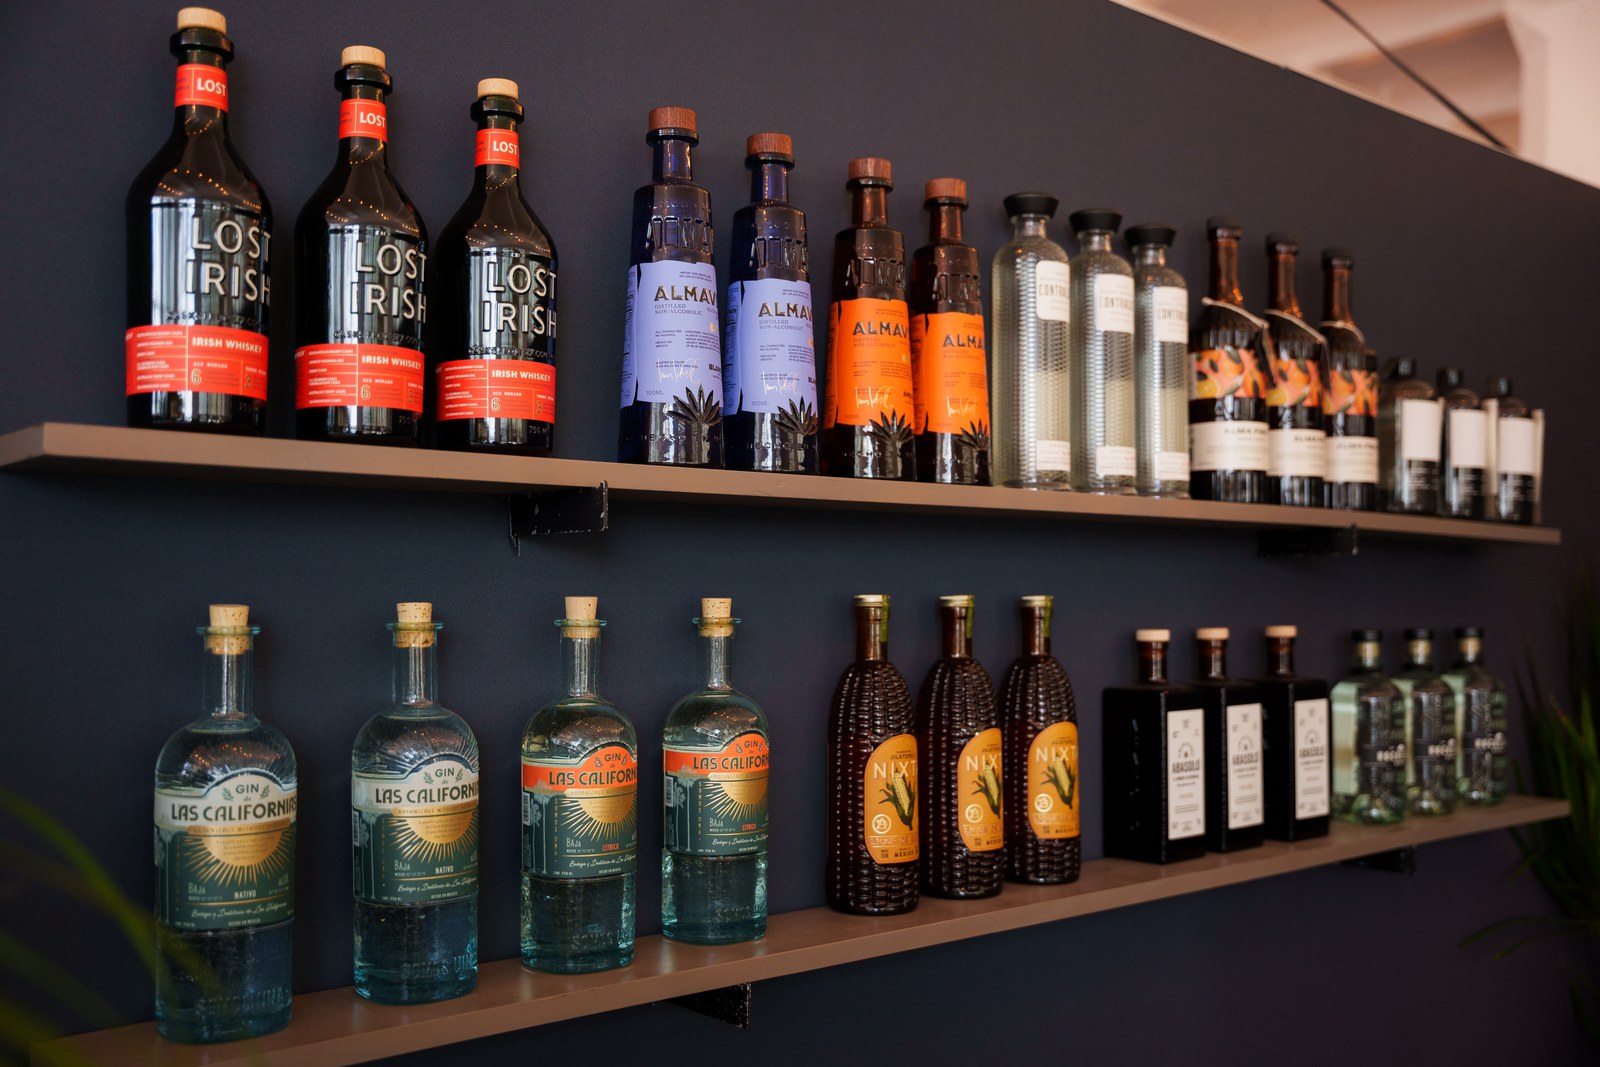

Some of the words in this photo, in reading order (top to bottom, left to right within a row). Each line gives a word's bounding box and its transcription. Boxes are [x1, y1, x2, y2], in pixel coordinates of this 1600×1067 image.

[197, 77, 227, 96] LOST
[360, 111, 385, 128] LOST
[493, 140, 517, 155] LOST
[193, 215, 272, 263] LOST
[356, 240, 427, 283] LOST
[187, 260, 271, 306] IRISH
[486, 261, 556, 300] LOST
[351, 281, 427, 323] IRISH
[483, 300, 557, 338] IRISH
[654, 308, 703, 316] NON-ALCOHOLIC
[192, 337, 223, 349] IRISH
[225, 340, 263, 354] WHISKEY
[943, 334, 983, 349] ALMA
[362, 355, 389, 365] IRISH
[391, 357, 421, 370] WHISKEY
[191, 368, 202, 385] 6
[245, 373, 252, 390] 3
[492, 369, 518, 379] IRISH
[520, 372, 551, 382] WHISKEY
[361, 384, 371, 400] 6
[491, 397, 501, 412] 6
[536, 400, 543, 415] 3
[744, 740, 758, 749] GIN
[604, 753, 621, 762] GIN
[1036, 745, 1077, 763] NIXT
[1232, 752, 1259, 766] ABASOLO
[693, 756, 718, 769] LAS
[874, 760, 917, 779] NIXT
[1171, 759, 1200, 774] ABASOLO
[435, 767, 455, 778] GIN
[549, 771, 575, 786] LAS
[235, 783, 259, 794] GIN
[376, 788, 402, 804] LAS
[406, 780, 479, 804] CALIFORNI
[172, 803, 199, 821] LAS
[709, 817, 724, 827] BAJA
[566, 837, 582, 848] BAJA
[394, 859, 411, 871] BAJA
[435, 865, 454, 875] NATIVO
[188, 882, 206, 895] BAJA
[234, 889, 257, 900] NATIVO
